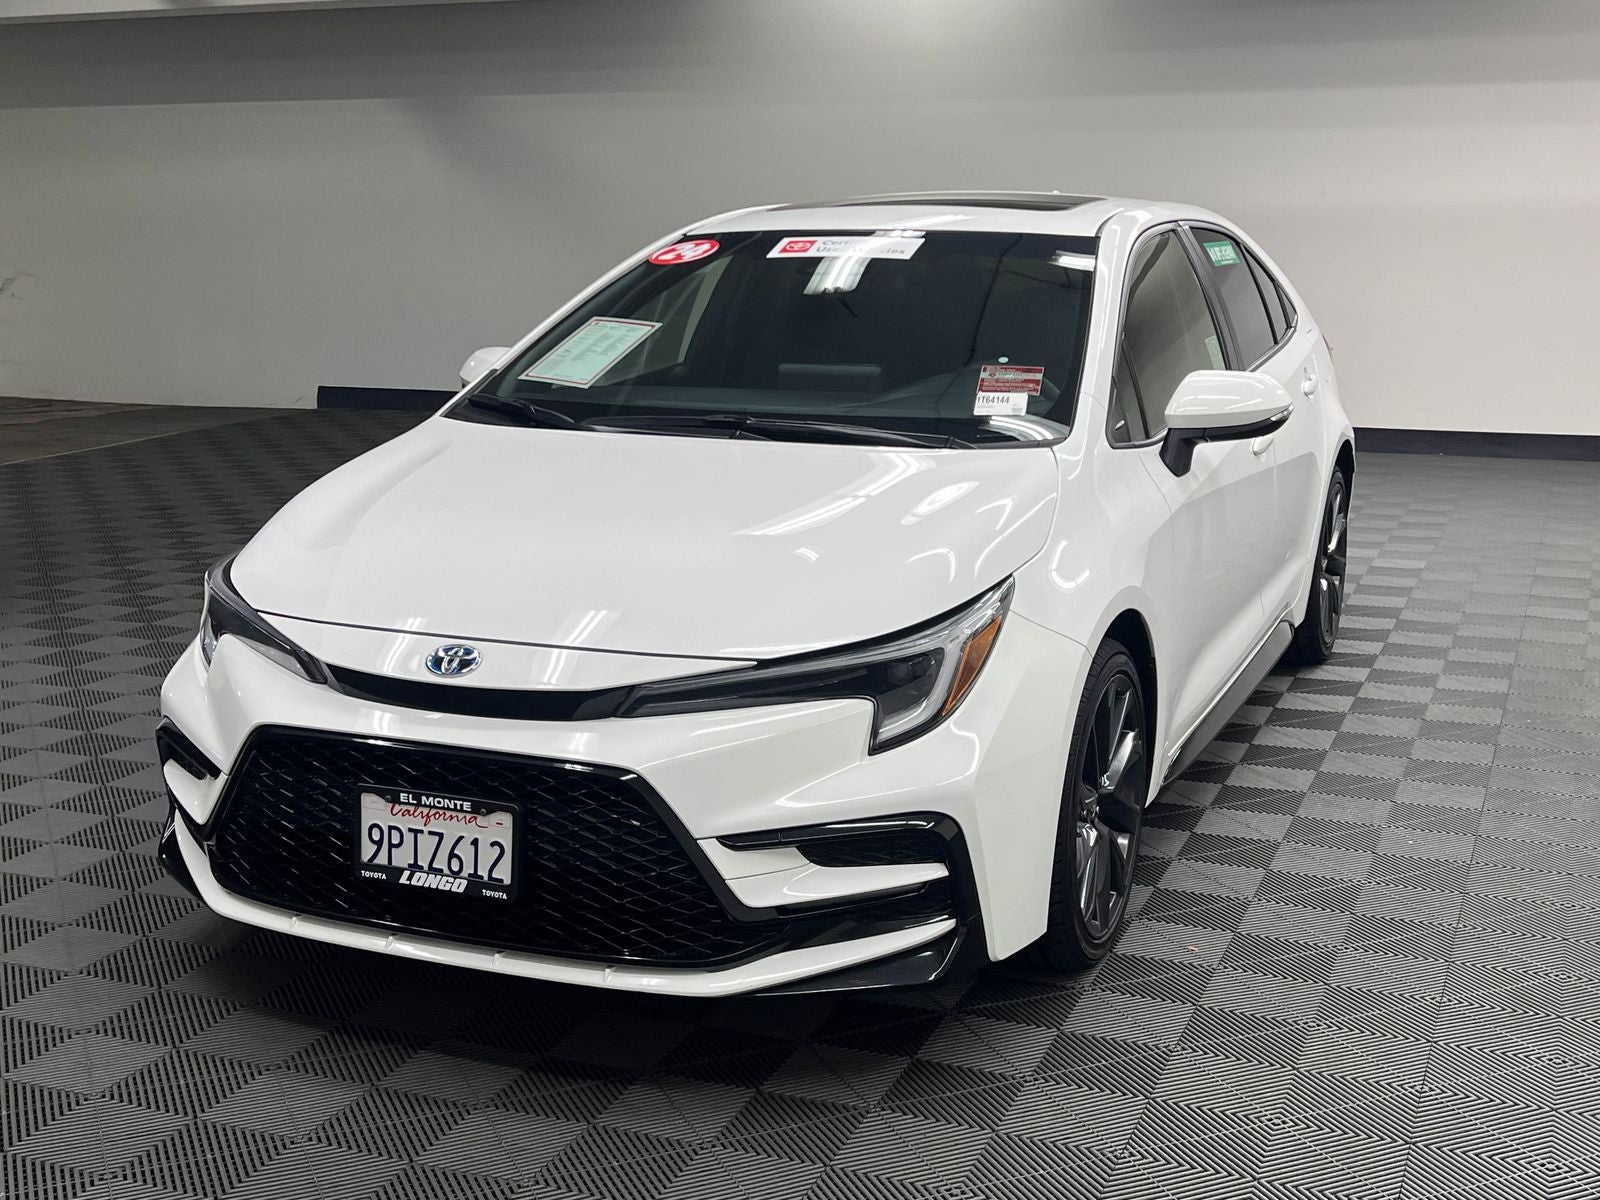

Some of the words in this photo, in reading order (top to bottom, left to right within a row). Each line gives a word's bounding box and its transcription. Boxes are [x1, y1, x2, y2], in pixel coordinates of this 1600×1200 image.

[656, 242, 712, 261] 24
[400, 792, 417, 804] EL
[421, 795, 472, 811] MONTE
[390, 802, 489, 829] California
[367, 822, 506, 885] 9PIZ612
[360, 870, 387, 880] TOYOTA
[398, 870, 468, 893] LONGO
[482, 889, 507, 900] TOYOTA
